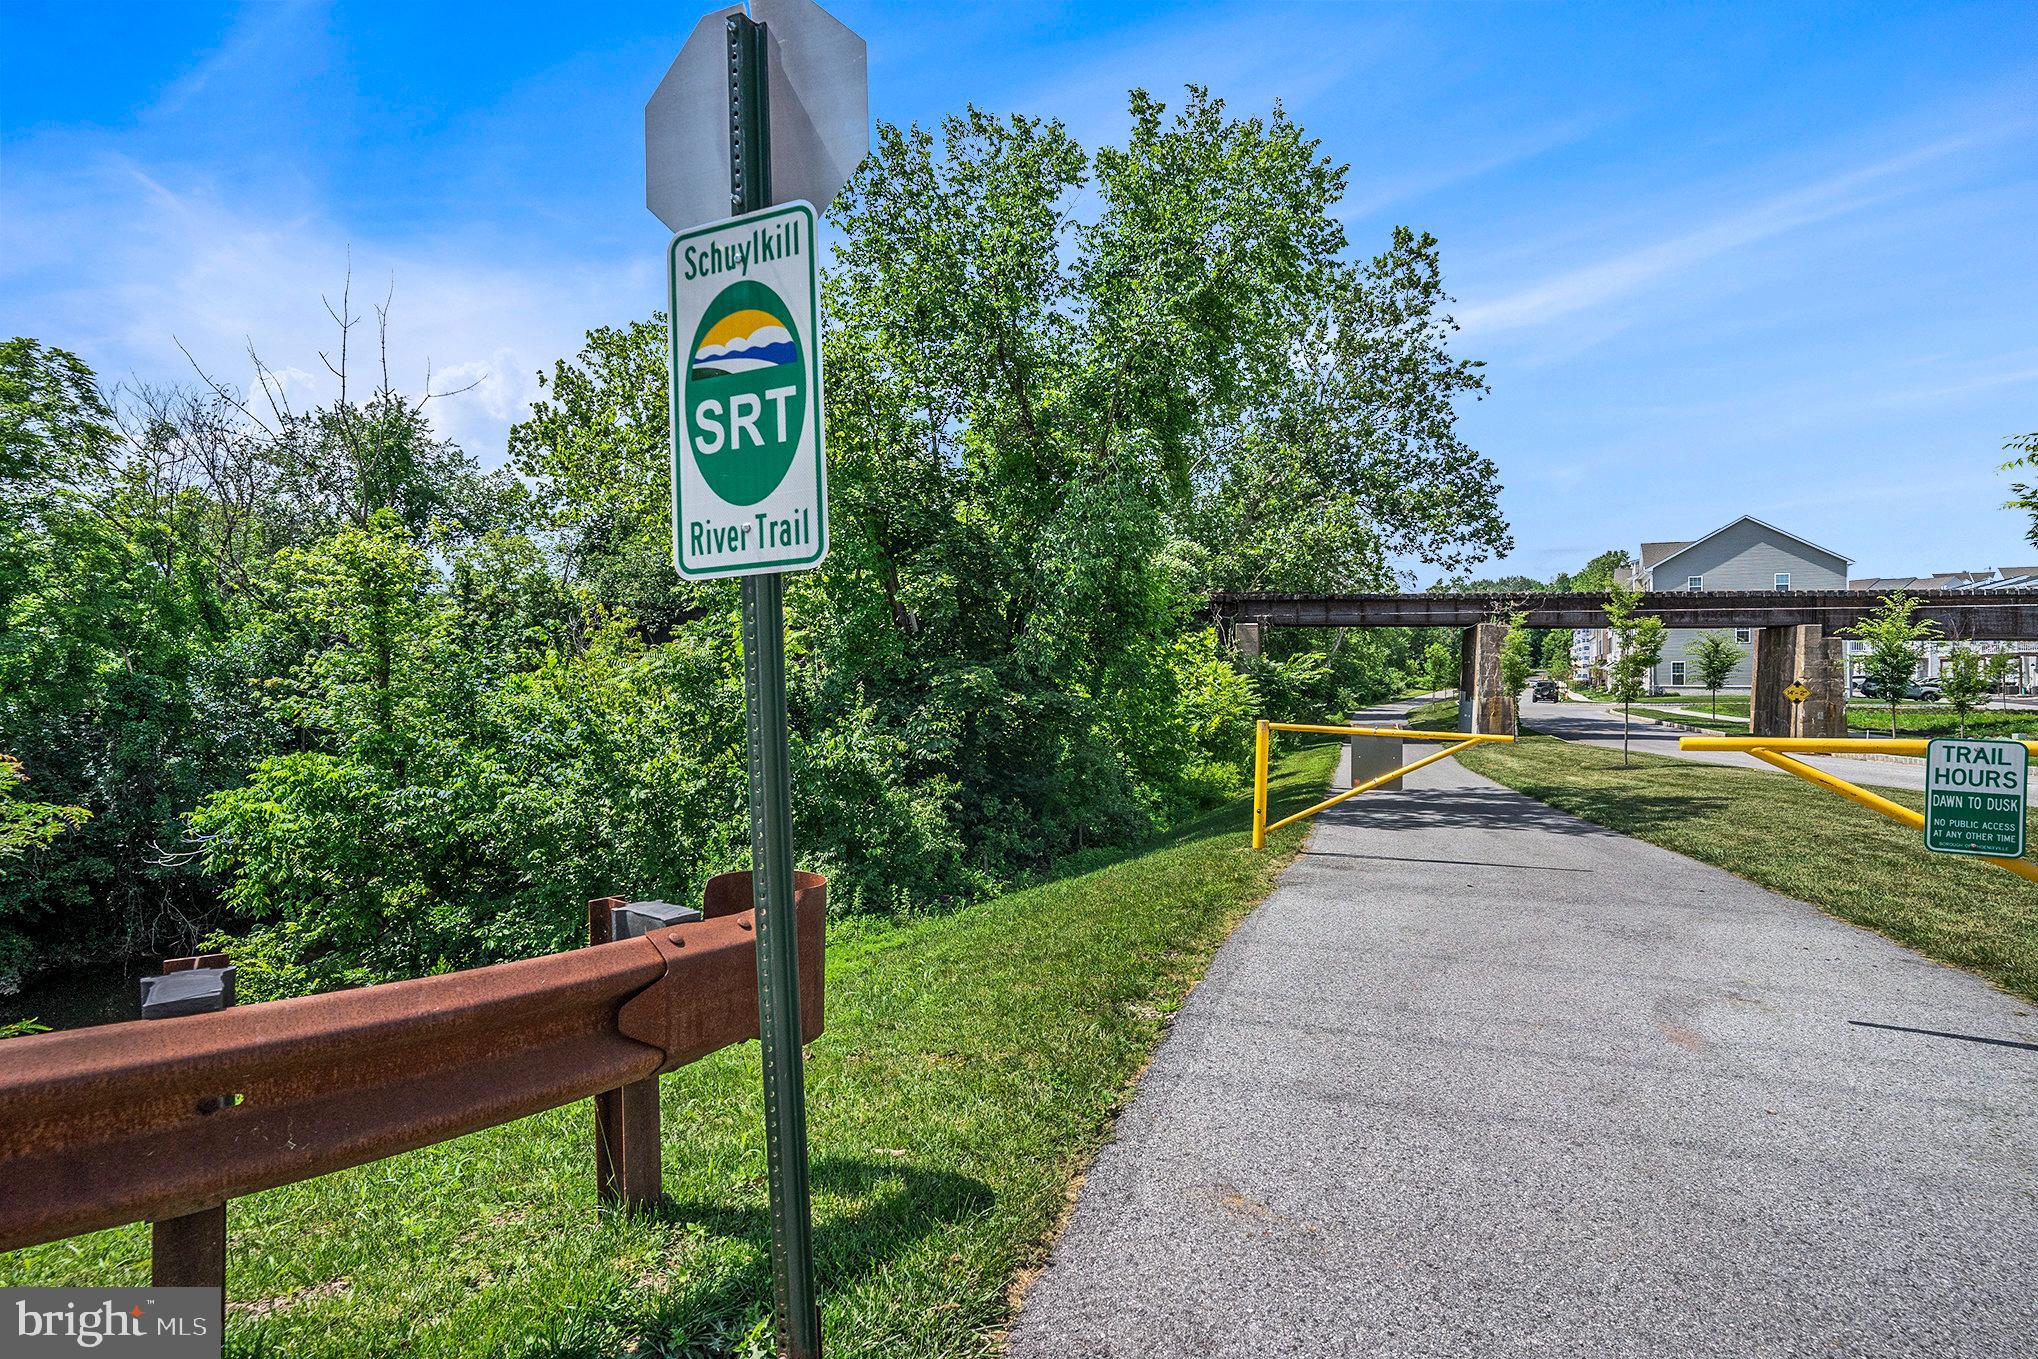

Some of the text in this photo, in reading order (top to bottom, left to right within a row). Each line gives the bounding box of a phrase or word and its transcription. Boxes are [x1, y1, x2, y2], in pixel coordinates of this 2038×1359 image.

[684, 219, 800, 281] Schuylkill
[694, 385, 797, 455] SRT
[690, 508, 810, 556] River Trail
[1942, 745, 2012, 766] TRAIL
[1934, 767, 2018, 789] HOURS
[1932, 794, 2018, 812] DAWN TO DUSK
[1934, 818, 2016, 832] NO PUBLIC ACCESS
[1933, 829, 2016, 843] AT ANY OTHER TIME
